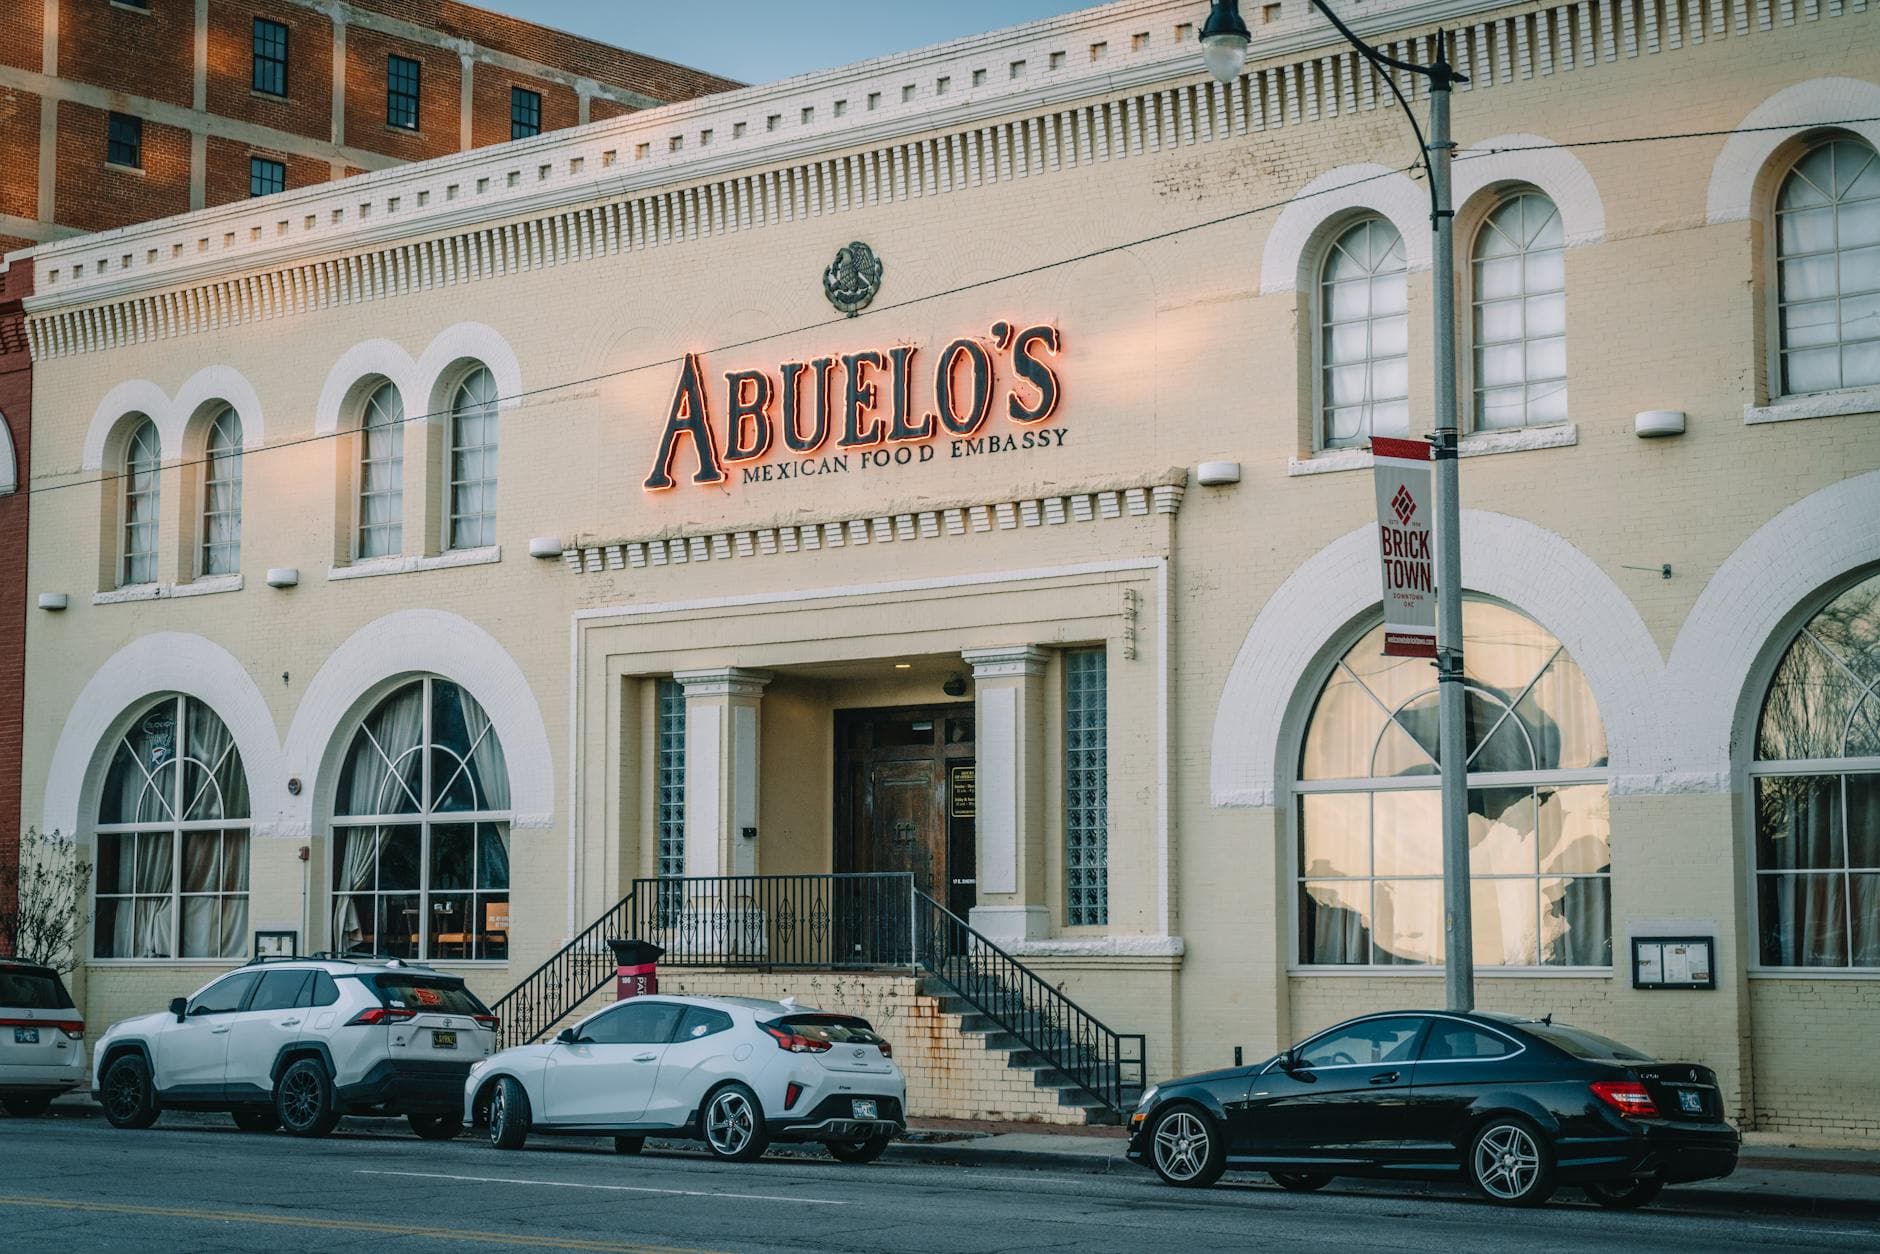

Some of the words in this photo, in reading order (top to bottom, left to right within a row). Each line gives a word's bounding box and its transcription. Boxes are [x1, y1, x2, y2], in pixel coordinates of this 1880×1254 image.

[642, 320, 1061, 491] ABUELO'S
[743, 455, 849, 485] MEXICAN
[860, 445, 935, 470] FOOD
[950, 428, 1069, 458] EMBASSY
[1381, 525, 1430, 560] BRICK
[1383, 559, 1432, 594] TOWN
[1393, 592, 1424, 601] DOWNTOWN
